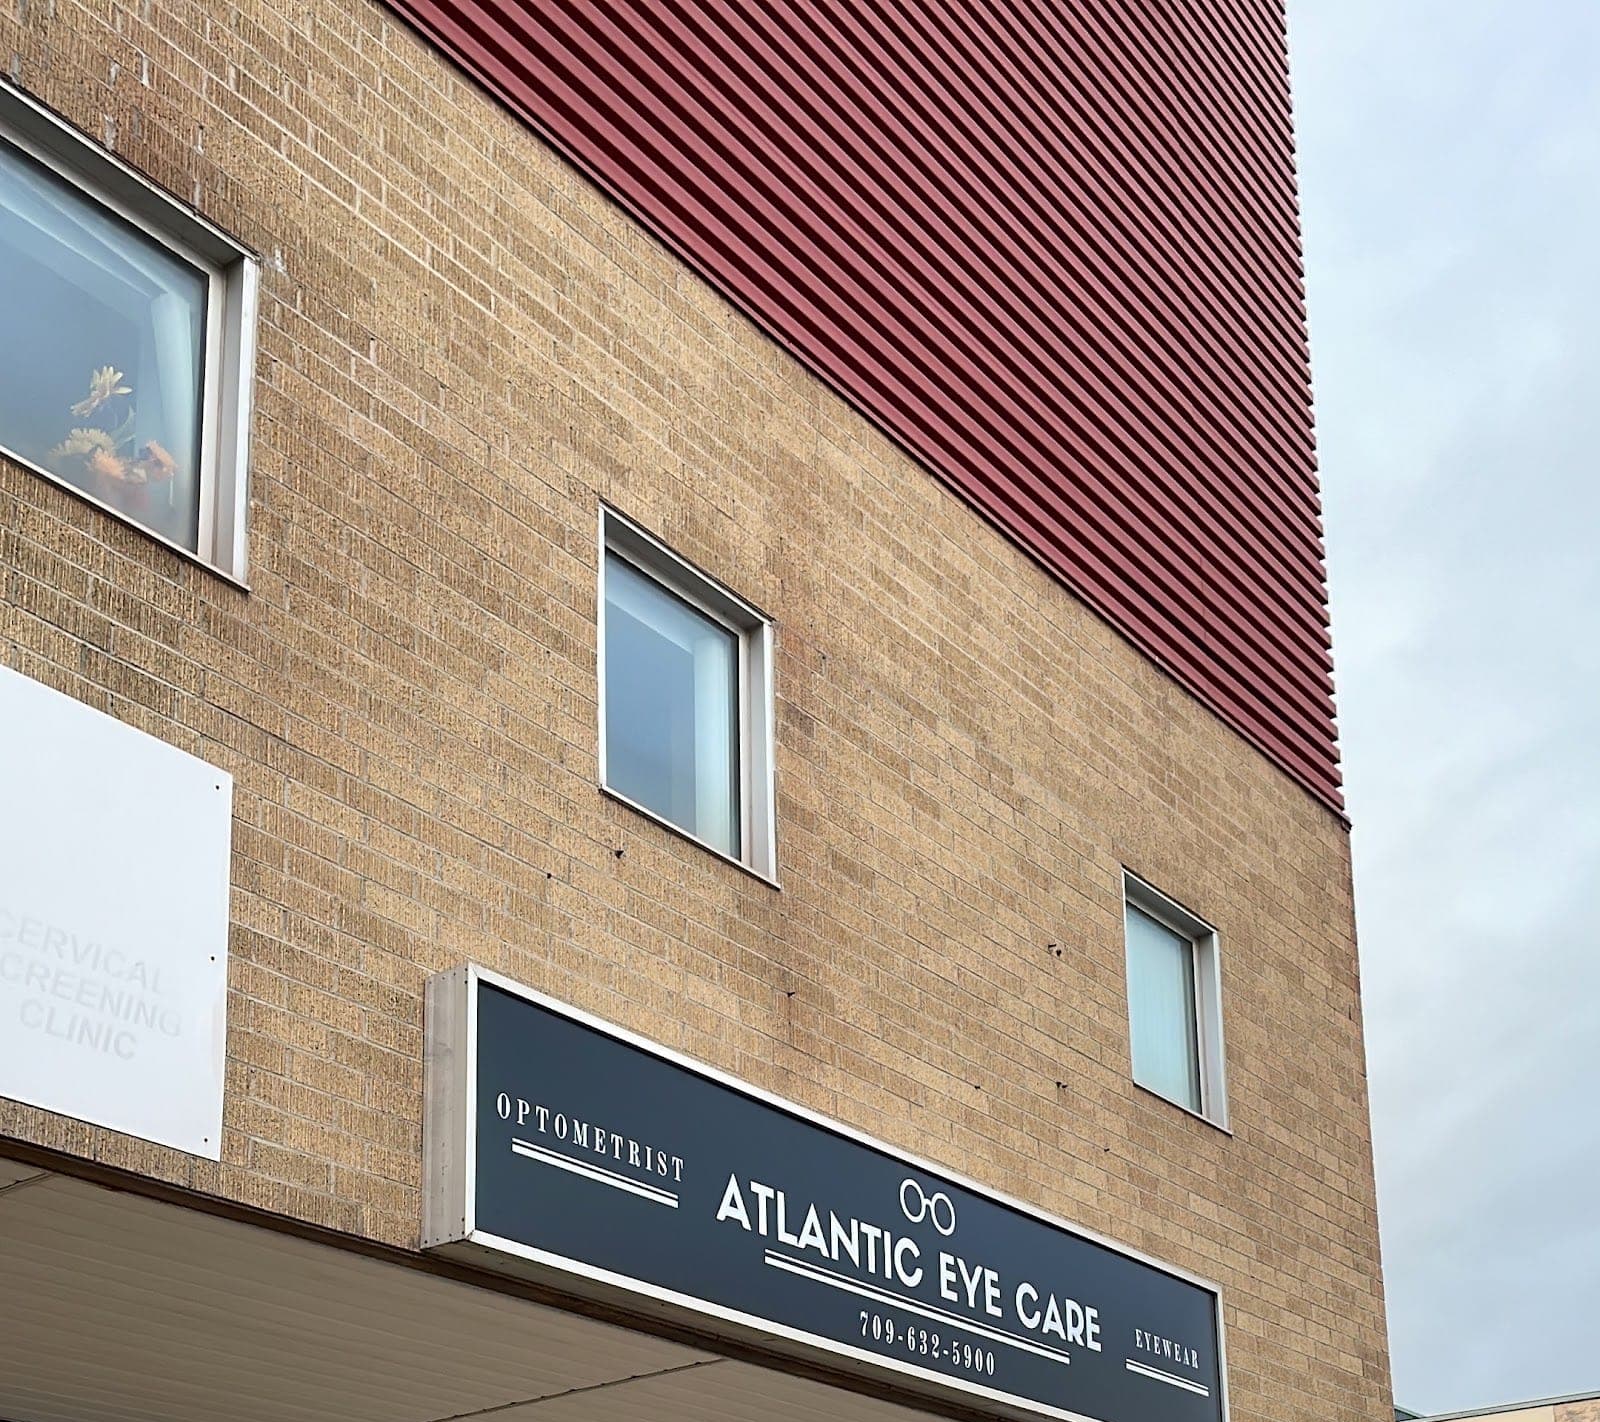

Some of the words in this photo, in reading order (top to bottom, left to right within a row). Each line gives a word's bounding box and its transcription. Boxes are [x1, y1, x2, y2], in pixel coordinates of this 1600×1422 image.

[0, 951, 182, 1037] CREENING
[19, 997, 137, 1061] CLINIC
[496, 1092, 685, 1183] OPTOMETRIST
[715, 1172, 923, 1288] ATLANTIC
[938, 1250, 1003, 1318] EYE
[1014, 1281, 1102, 1353] CARE
[859, 1310, 995, 1377] 709-632-5900
[1134, 1328, 1200, 1370] EYEWEAR
